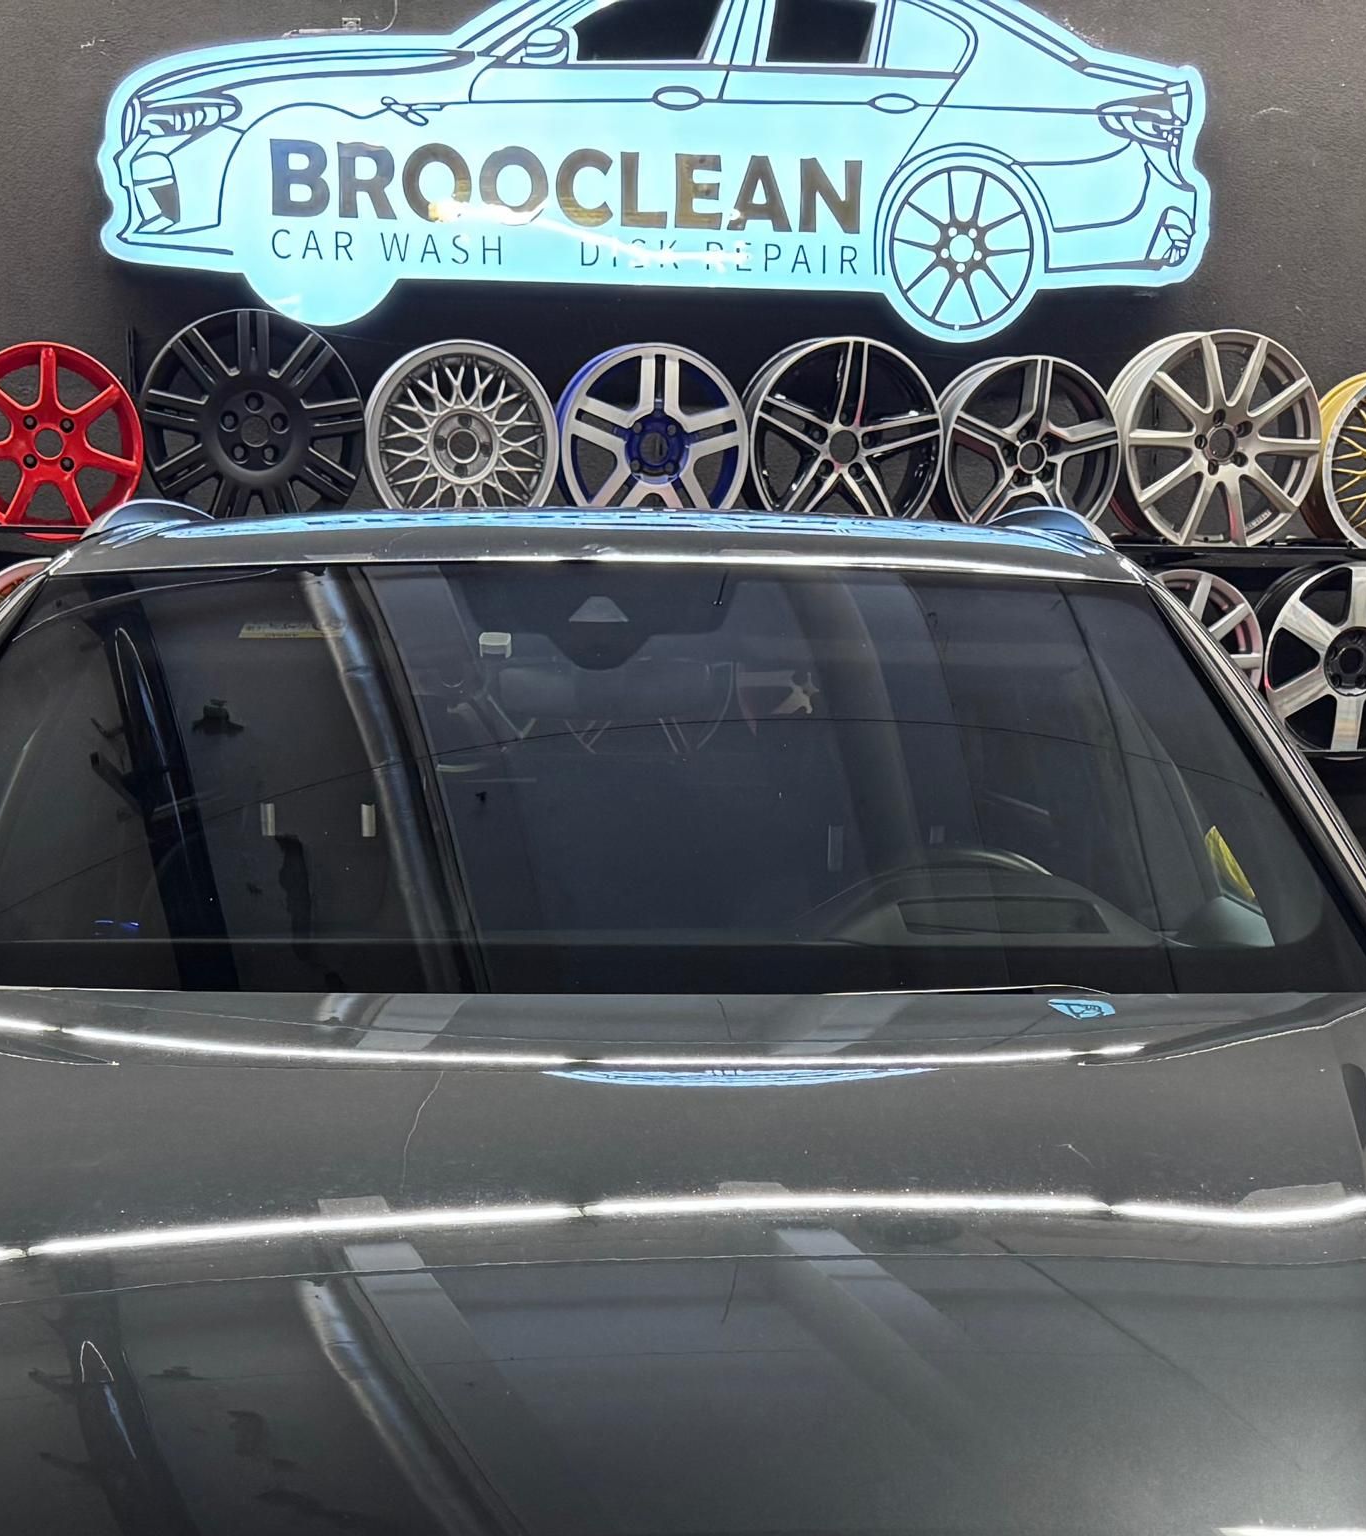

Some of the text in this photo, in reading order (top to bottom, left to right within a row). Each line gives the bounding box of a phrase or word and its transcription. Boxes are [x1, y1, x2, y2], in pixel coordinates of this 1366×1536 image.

[269, 138, 863, 234] BROOCLEAN
[271, 228, 354, 261] CAR
[383, 232, 503, 266] WASH
